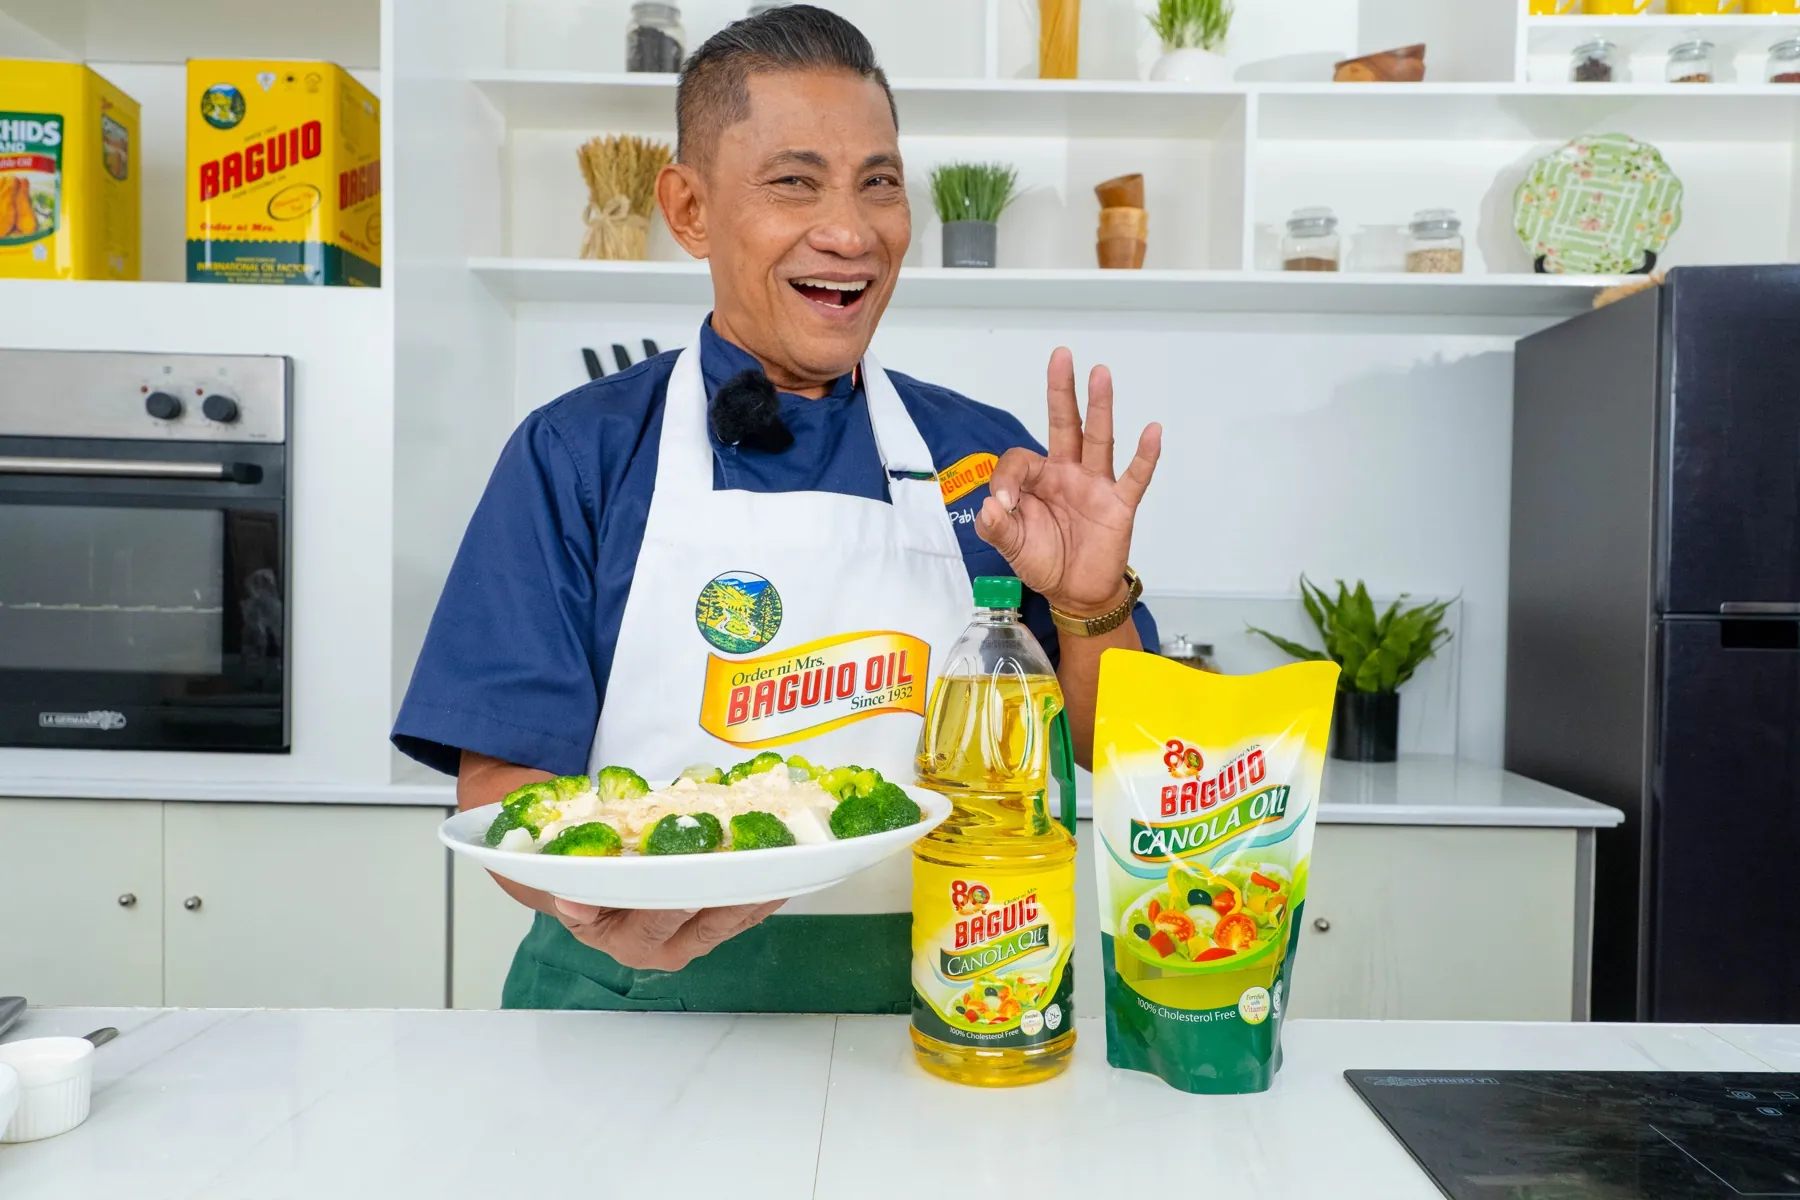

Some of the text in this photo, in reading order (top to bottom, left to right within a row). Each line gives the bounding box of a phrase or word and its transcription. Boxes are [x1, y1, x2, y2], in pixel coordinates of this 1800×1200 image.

[0, 119, 61, 147] HIDS
[200, 120, 321, 203] BAGUIO
[732, 655, 826, 687] Order ni Mrs.
[726, 650, 913, 727] BAGUIO OIL
[850, 686, 913, 710] Since 1932
[1163, 739, 1204, 772] 80
[1160, 749, 1267, 817] BAGUIO
[1133, 788, 1286, 856] CANOLA OIL
[951, 879, 991, 909] 80
[955, 893, 1038, 950] BAGUIO
[947, 926, 1045, 976] CANOLA OIL
[1137, 997, 1236, 1022] 100% Cholesterol Free
[1243, 1004, 1268, 1013] Vitamin
[1253, 1013, 1260, 1021] A
[949, 1027, 1020, 1040] 100% Cholesterol Free
